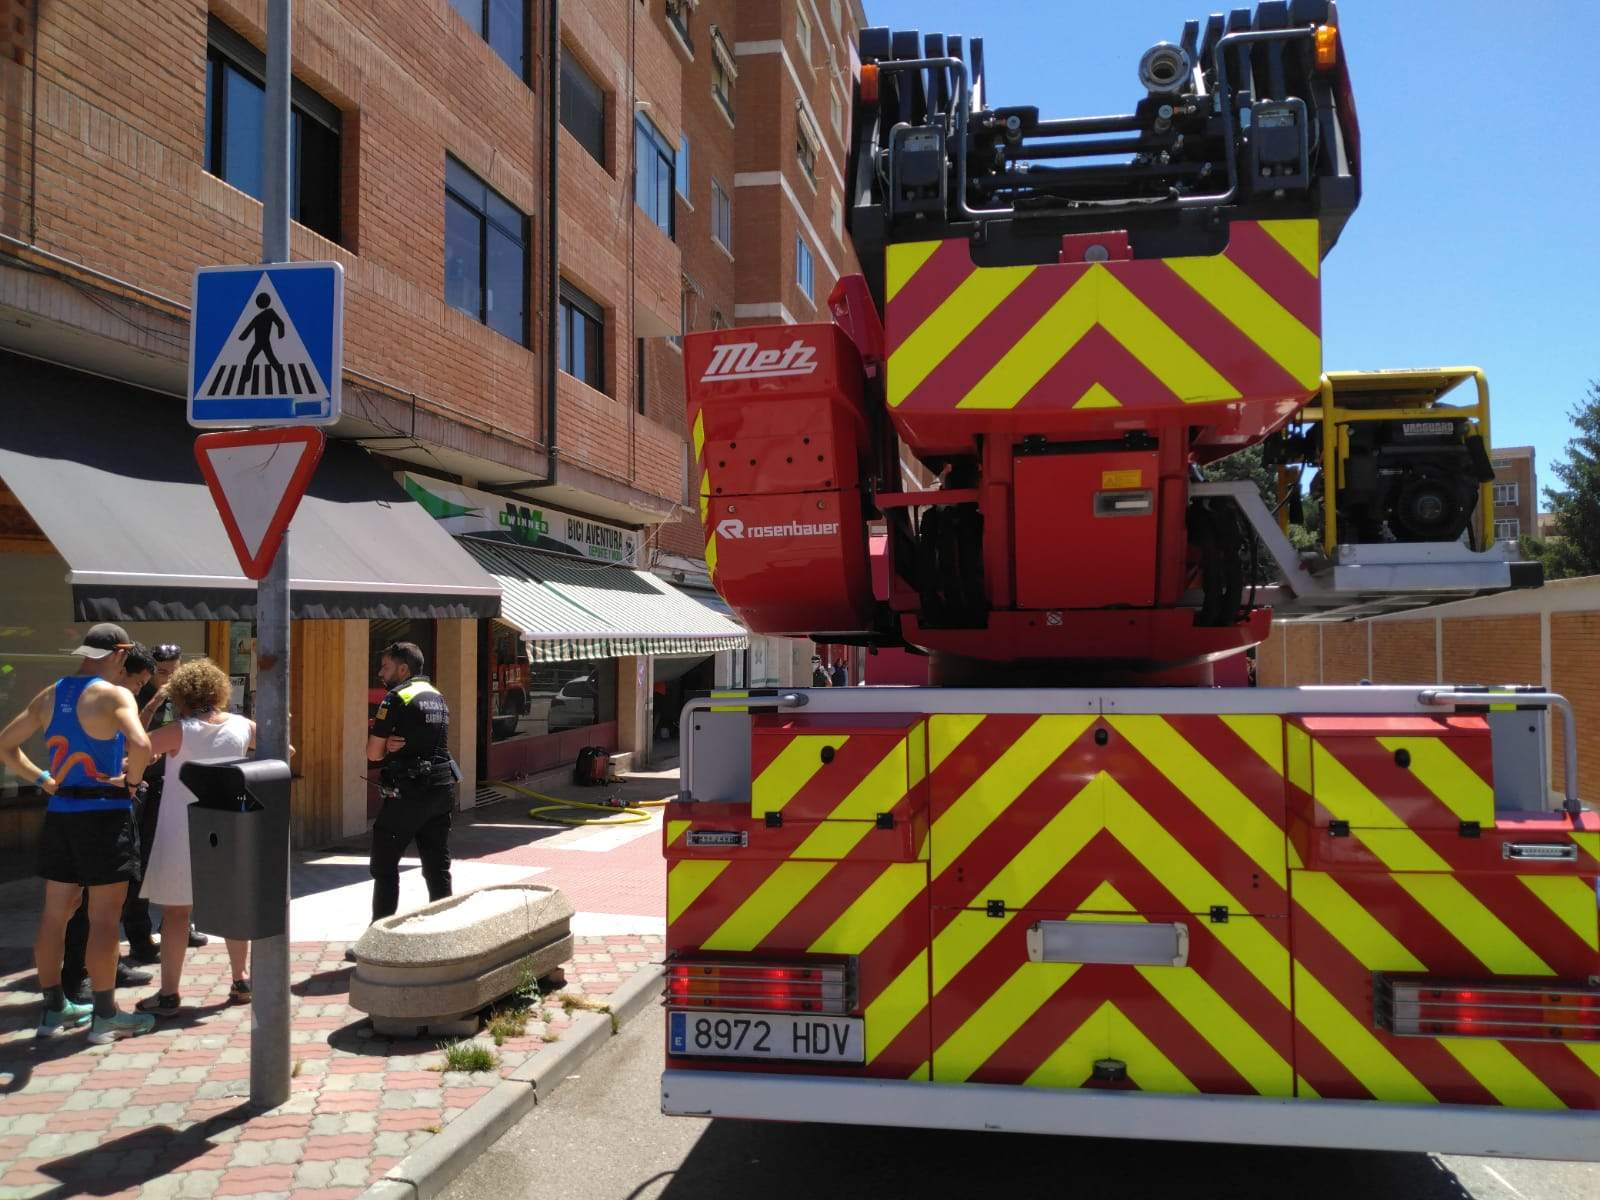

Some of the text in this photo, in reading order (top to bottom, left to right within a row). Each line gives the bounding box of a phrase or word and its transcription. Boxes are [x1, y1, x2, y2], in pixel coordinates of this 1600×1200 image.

[701, 339, 818, 382] Metz
[1403, 422, 1454, 434] VANGUARD
[501, 513, 548, 533] TWINNER
[747, 521, 840, 538] rosenbauer
[568, 518, 584, 542] BICI
[586, 524, 623, 550] AVENTURA
[675, 1037, 682, 1046] E
[694, 1018, 850, 1055] 8972 HDV
